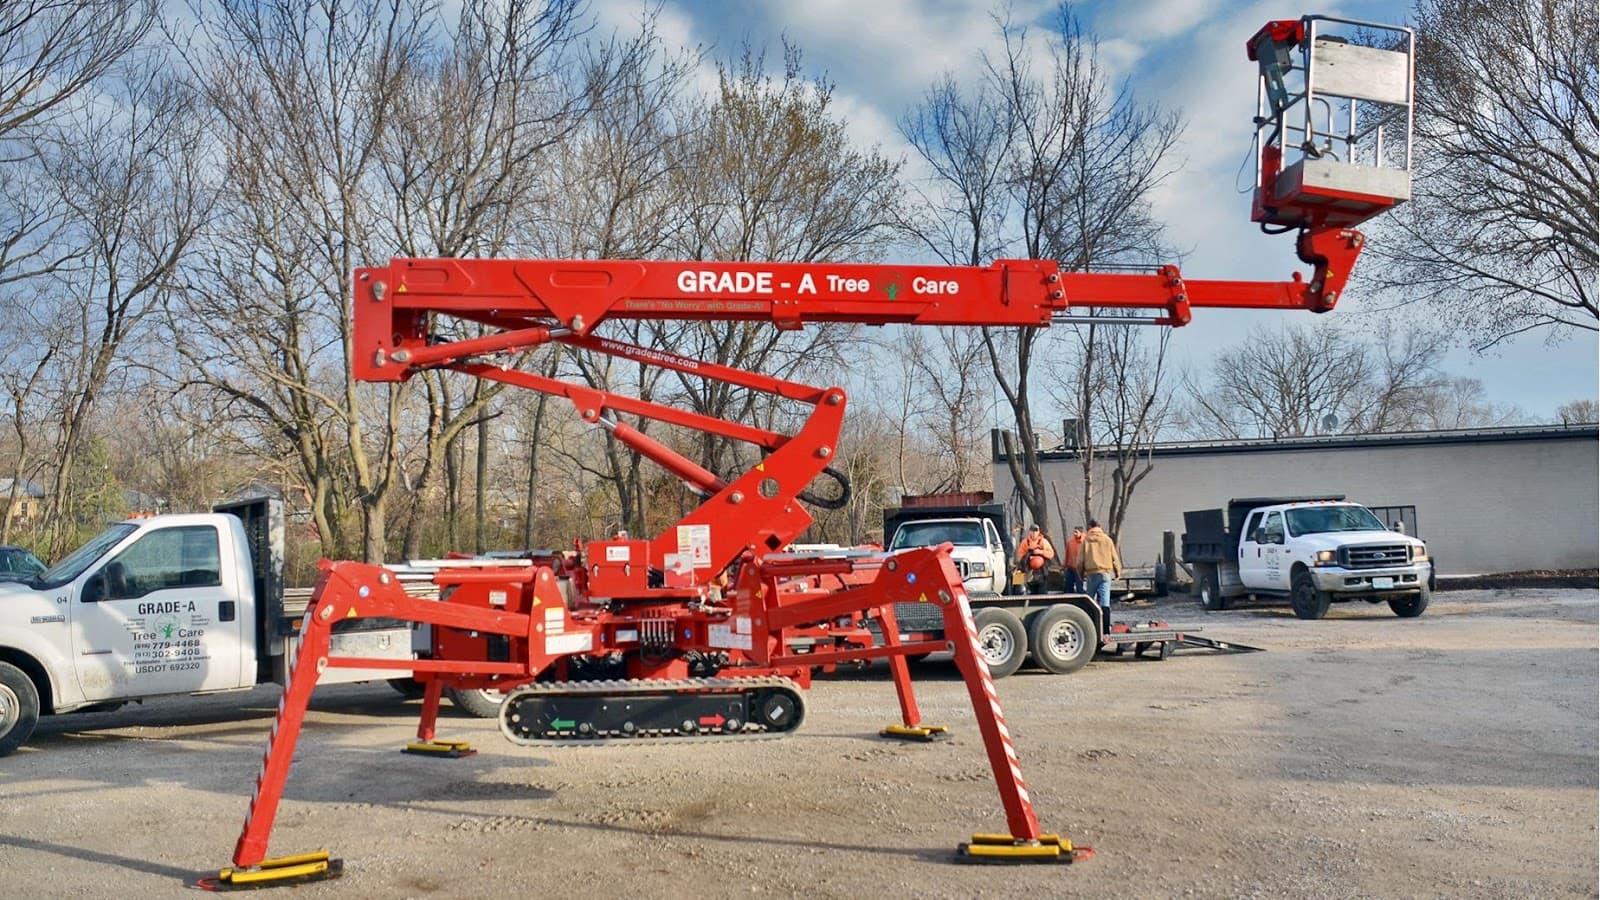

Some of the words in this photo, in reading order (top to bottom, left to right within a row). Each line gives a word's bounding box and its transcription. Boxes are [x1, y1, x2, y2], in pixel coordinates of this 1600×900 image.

[677, 270, 773, 294] GRADE
[797, 273, 817, 295] A
[826, 275, 870, 293] Tree
[912, 277, 959, 295] Care
[600, 339, 698, 369] www.gradeatree.com
[56, 596, 68, 604] 04
[138, 600, 196, 615] GRADE-A
[132, 632, 157, 641] Tree
[178, 628, 204, 638] Care
[152, 640, 200, 650] 779-4468
[135, 664, 167, 674] USDOT
[169, 662, 200, 672] 692320
